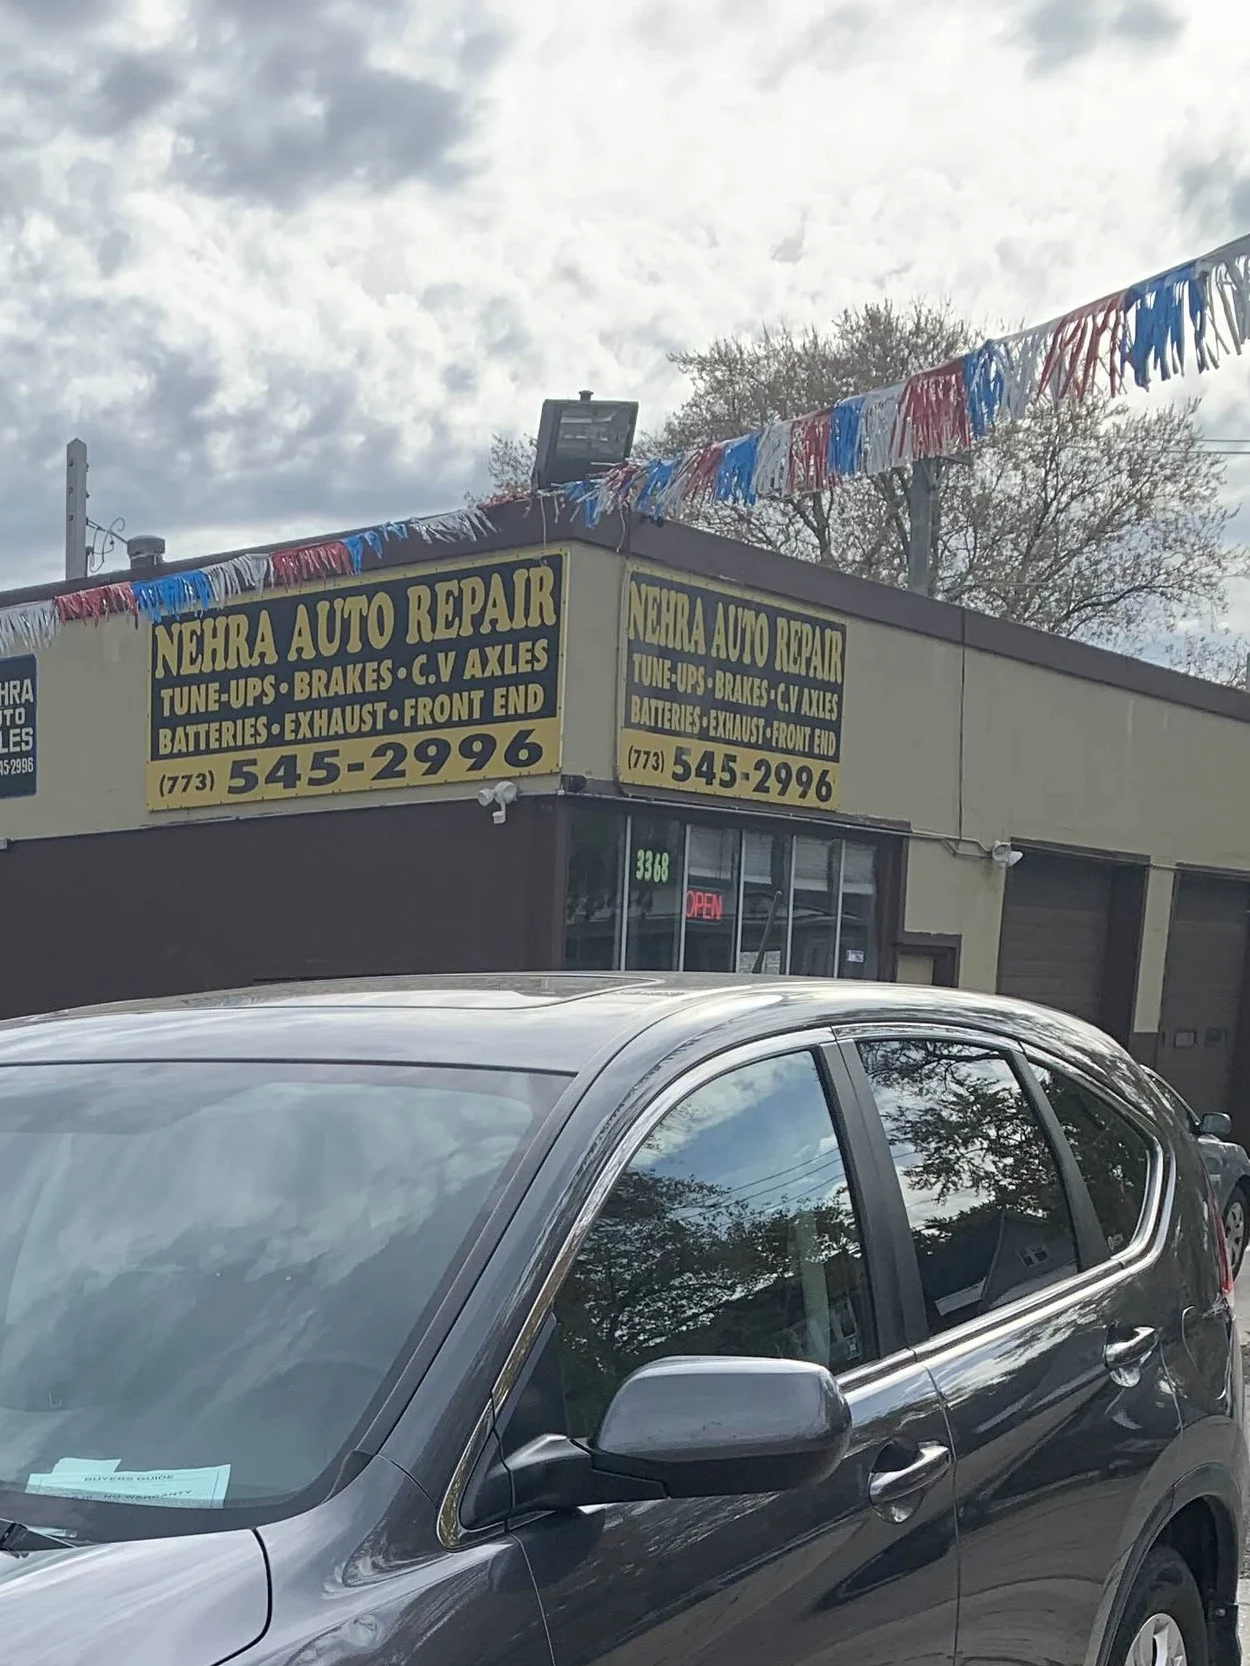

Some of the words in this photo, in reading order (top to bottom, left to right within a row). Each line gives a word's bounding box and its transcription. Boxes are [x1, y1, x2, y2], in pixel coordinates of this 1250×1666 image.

[154, 609, 278, 679] NEHRA
[287, 592, 394, 661] AUTO
[405, 565, 557, 645] REPAIR
[628, 580, 706, 655] NEHRA
[711, 602, 770, 668] AUTO
[774, 616, 843, 684] REPAIR
[160, 677, 276, 718] TUNE-UPS
[293, 659, 392, 702] BRAKES
[463, 639, 548, 680] AXLES
[632, 653, 705, 696] TUNE-UPS
[714, 670, 768, 708] BRAKES
[801, 688, 838, 721] AXLES
[158, 717, 268, 755] BATTERIES
[284, 701, 388, 741] EXHAUST
[404, 689, 484, 727] FRONT
[493, 683, 544, 717] END
[630, 695, 700, 734] BATTERIES
[709, 709, 765, 745] EXHAUST
[772, 720, 811, 751] FRONT
[813, 726, 836, 757] END
[159, 770, 215, 797] (773)
[227, 729, 543, 795] 545-2996
[628, 745, 665, 773] (773)
[671, 746, 833, 803] 545-2996
[635, 849, 669, 883] 3368
[686, 890, 723, 920] OPEN
